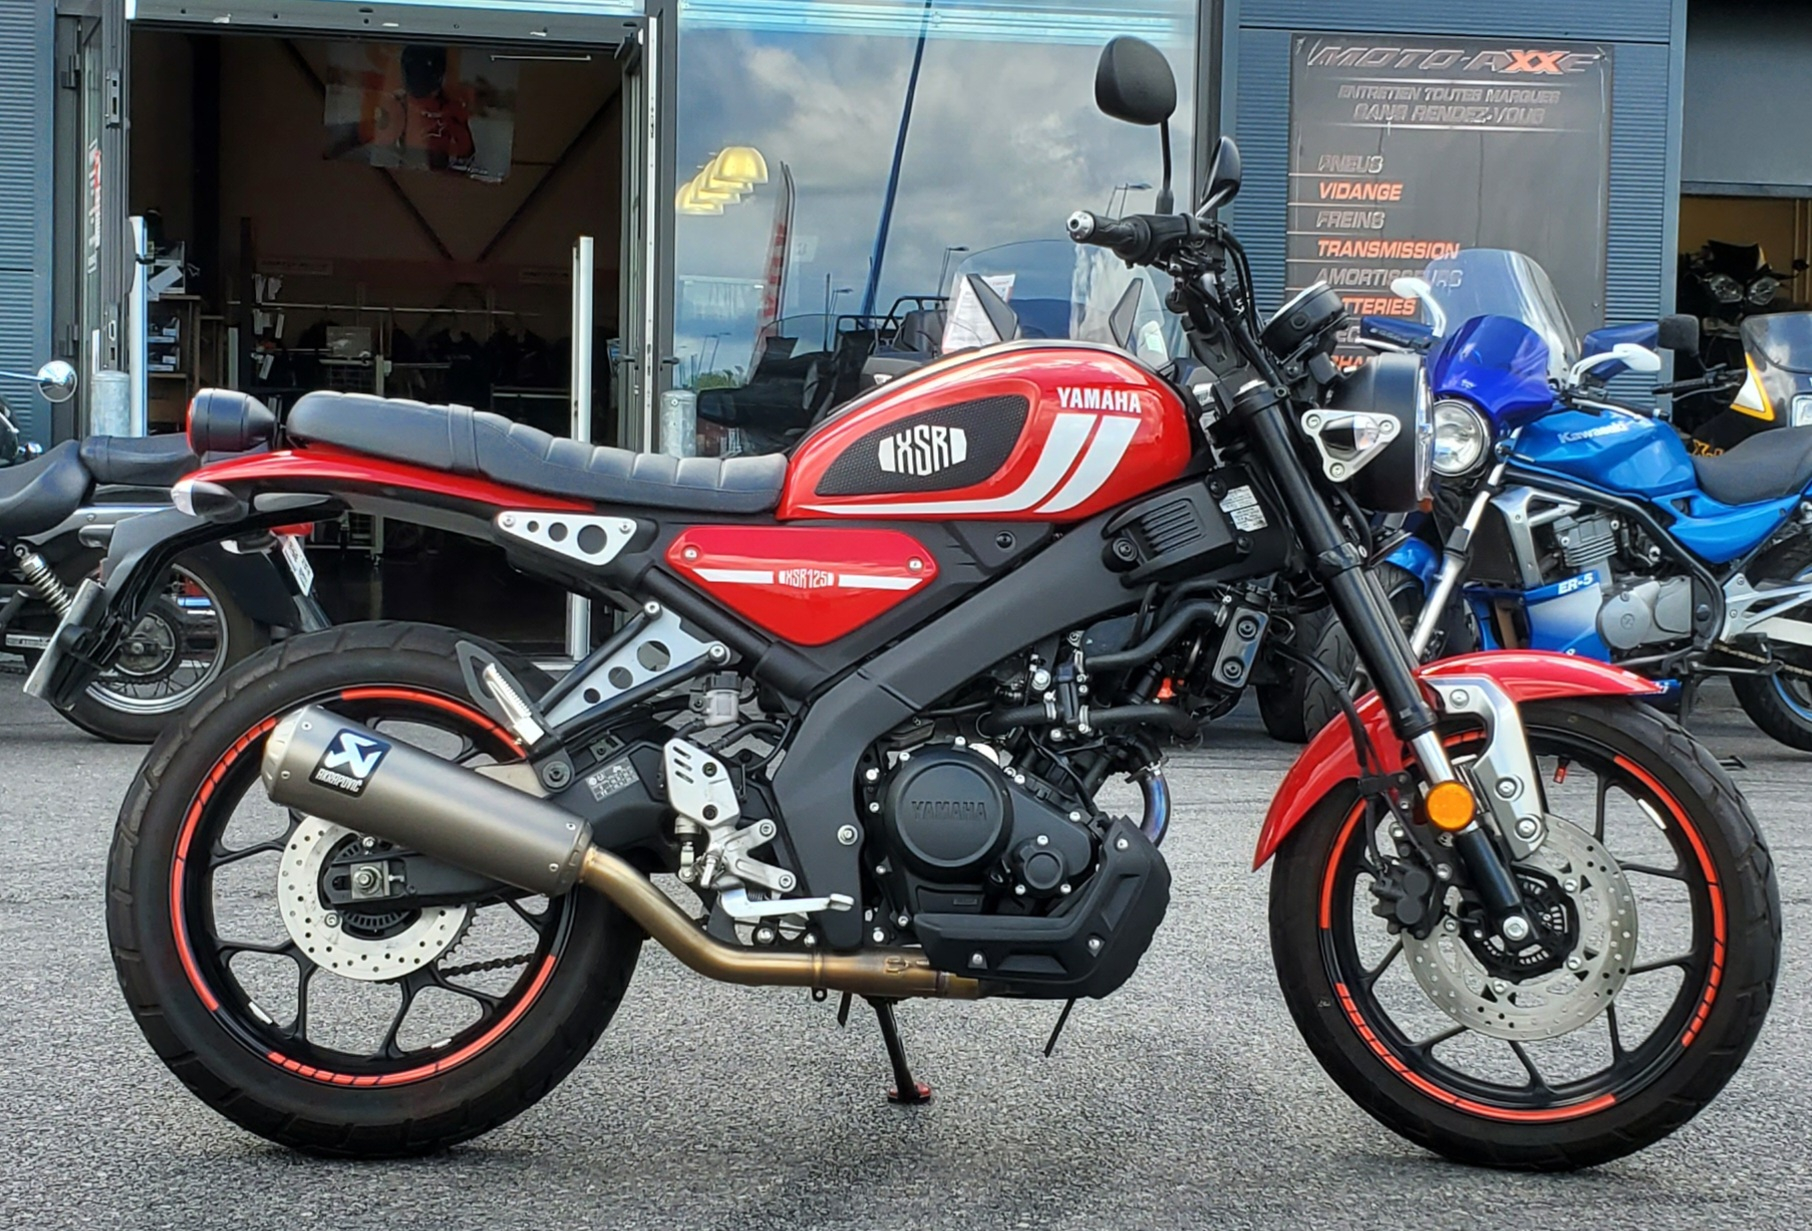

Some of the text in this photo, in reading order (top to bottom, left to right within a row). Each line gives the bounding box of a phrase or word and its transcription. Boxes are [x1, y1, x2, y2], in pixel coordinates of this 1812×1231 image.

[1307, 46, 1600, 74] MOTO-AXXE
[1338, 85, 1424, 100] ENTRETIEN
[1424, 87, 1483, 102] TOUTES
[1353, 103, 1546, 124] SANS RENDEZ-VOUS
[1318, 155, 1384, 174] PNEUS
[1319, 182, 1403, 201] VIDANGE
[1316, 211, 1386, 229] FREINS
[1317, 240, 1460, 260] TRANSMISSION
[1057, 387, 1142, 414] YAMAHA
[1557, 420, 1630, 444] Kawasaki
[895, 424, 951, 477] XSR
[784, 567, 828, 590] XSR125
[1558, 572, 1594, 595] ER-5
[911, 800, 987, 821] YAMAHA
